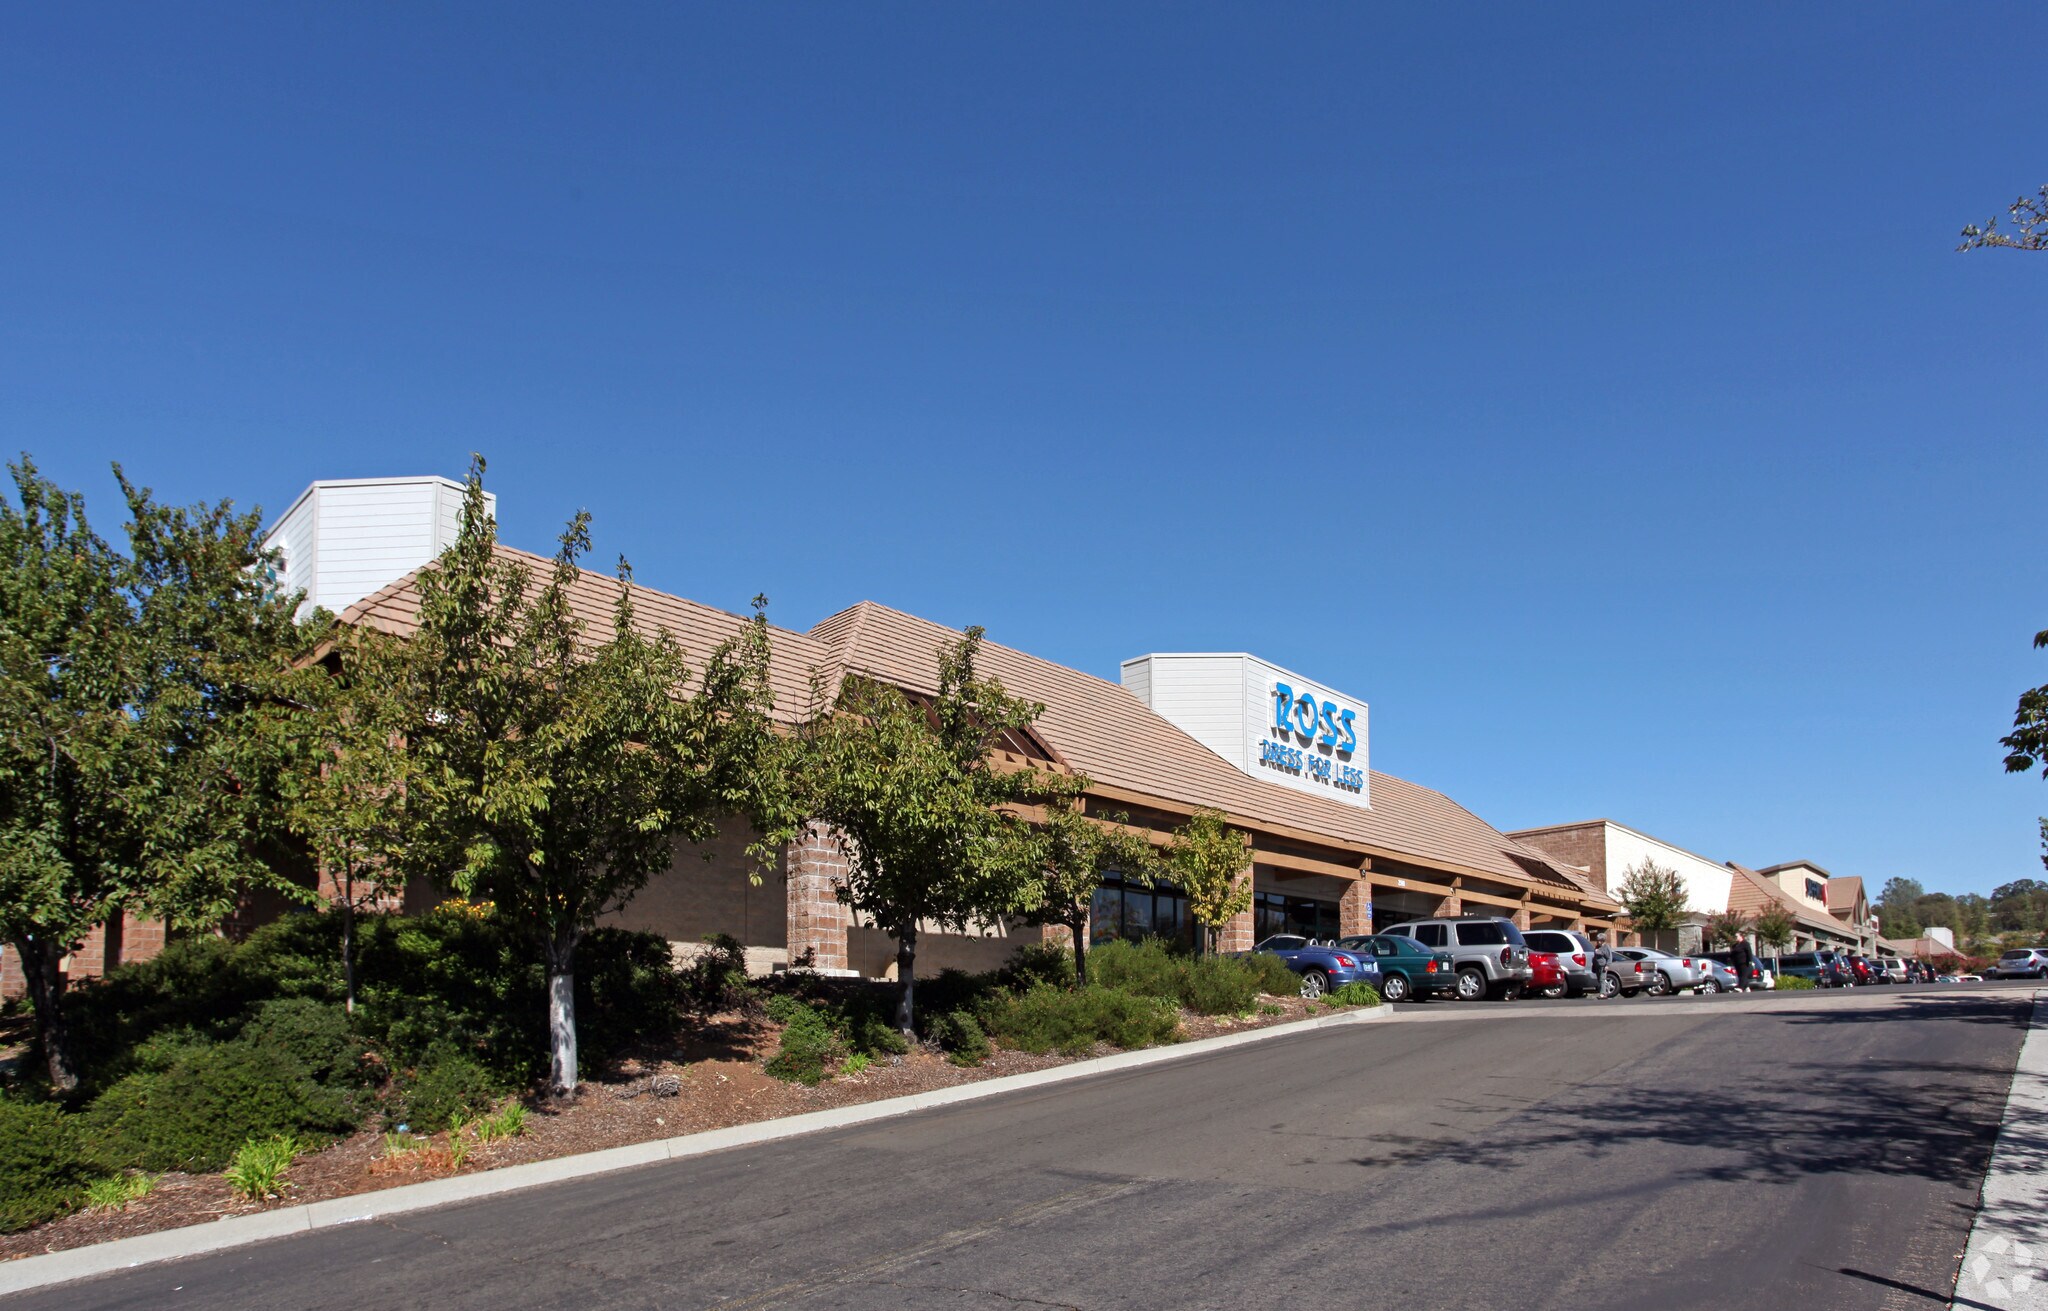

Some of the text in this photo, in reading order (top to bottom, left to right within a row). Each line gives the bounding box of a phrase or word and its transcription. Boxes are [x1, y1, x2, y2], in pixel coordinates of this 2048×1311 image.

[1272, 682, 1356, 753] ROSS
[1260, 739, 1363, 788] DRESS FOR LESS
